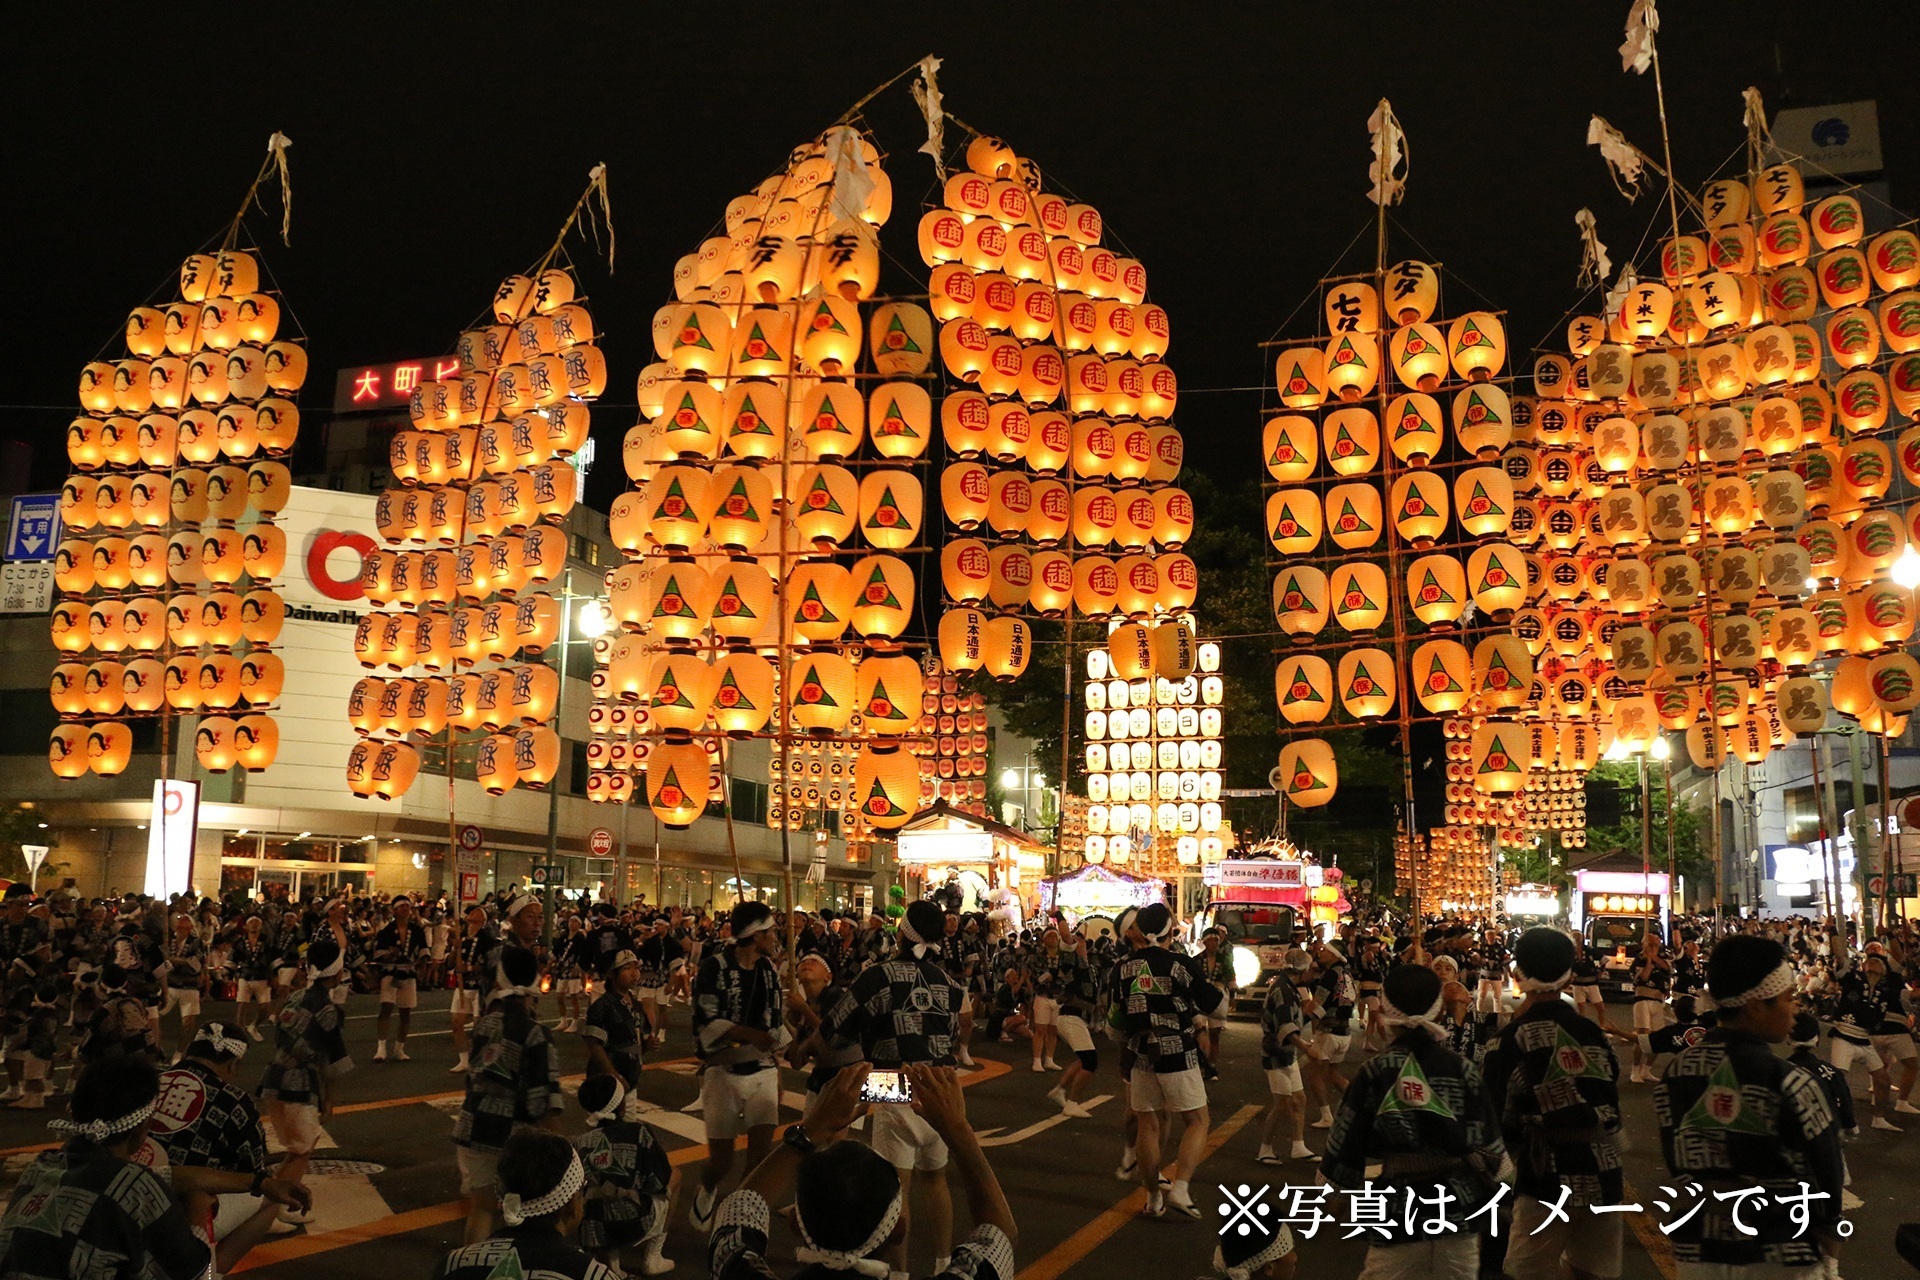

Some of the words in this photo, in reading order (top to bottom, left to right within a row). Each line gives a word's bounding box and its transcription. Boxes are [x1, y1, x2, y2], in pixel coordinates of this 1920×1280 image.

[1707, 185, 1728, 221] 七夕
[1766, 169, 1791, 206] 七夕
[183, 257, 201, 291] 七夕
[218, 256, 235, 293] 七夕
[1393, 261, 1424, 302] 七夕
[1332, 293, 1361, 332] 七夕
[1635, 290, 1655, 324] 下米一
[1699, 281, 1724, 317] 下米一
[21, 521, 48, 535] 専用
[4, 568, 51, 579] ここから
[284, 603, 339, 624] Daiwa
[966, 613, 980, 660] 日本通運
[1009, 624, 1024, 668] 日本通運
[1136, 629, 1150, 670] 日本通運
[1177, 627, 1190, 669] 日本通運
